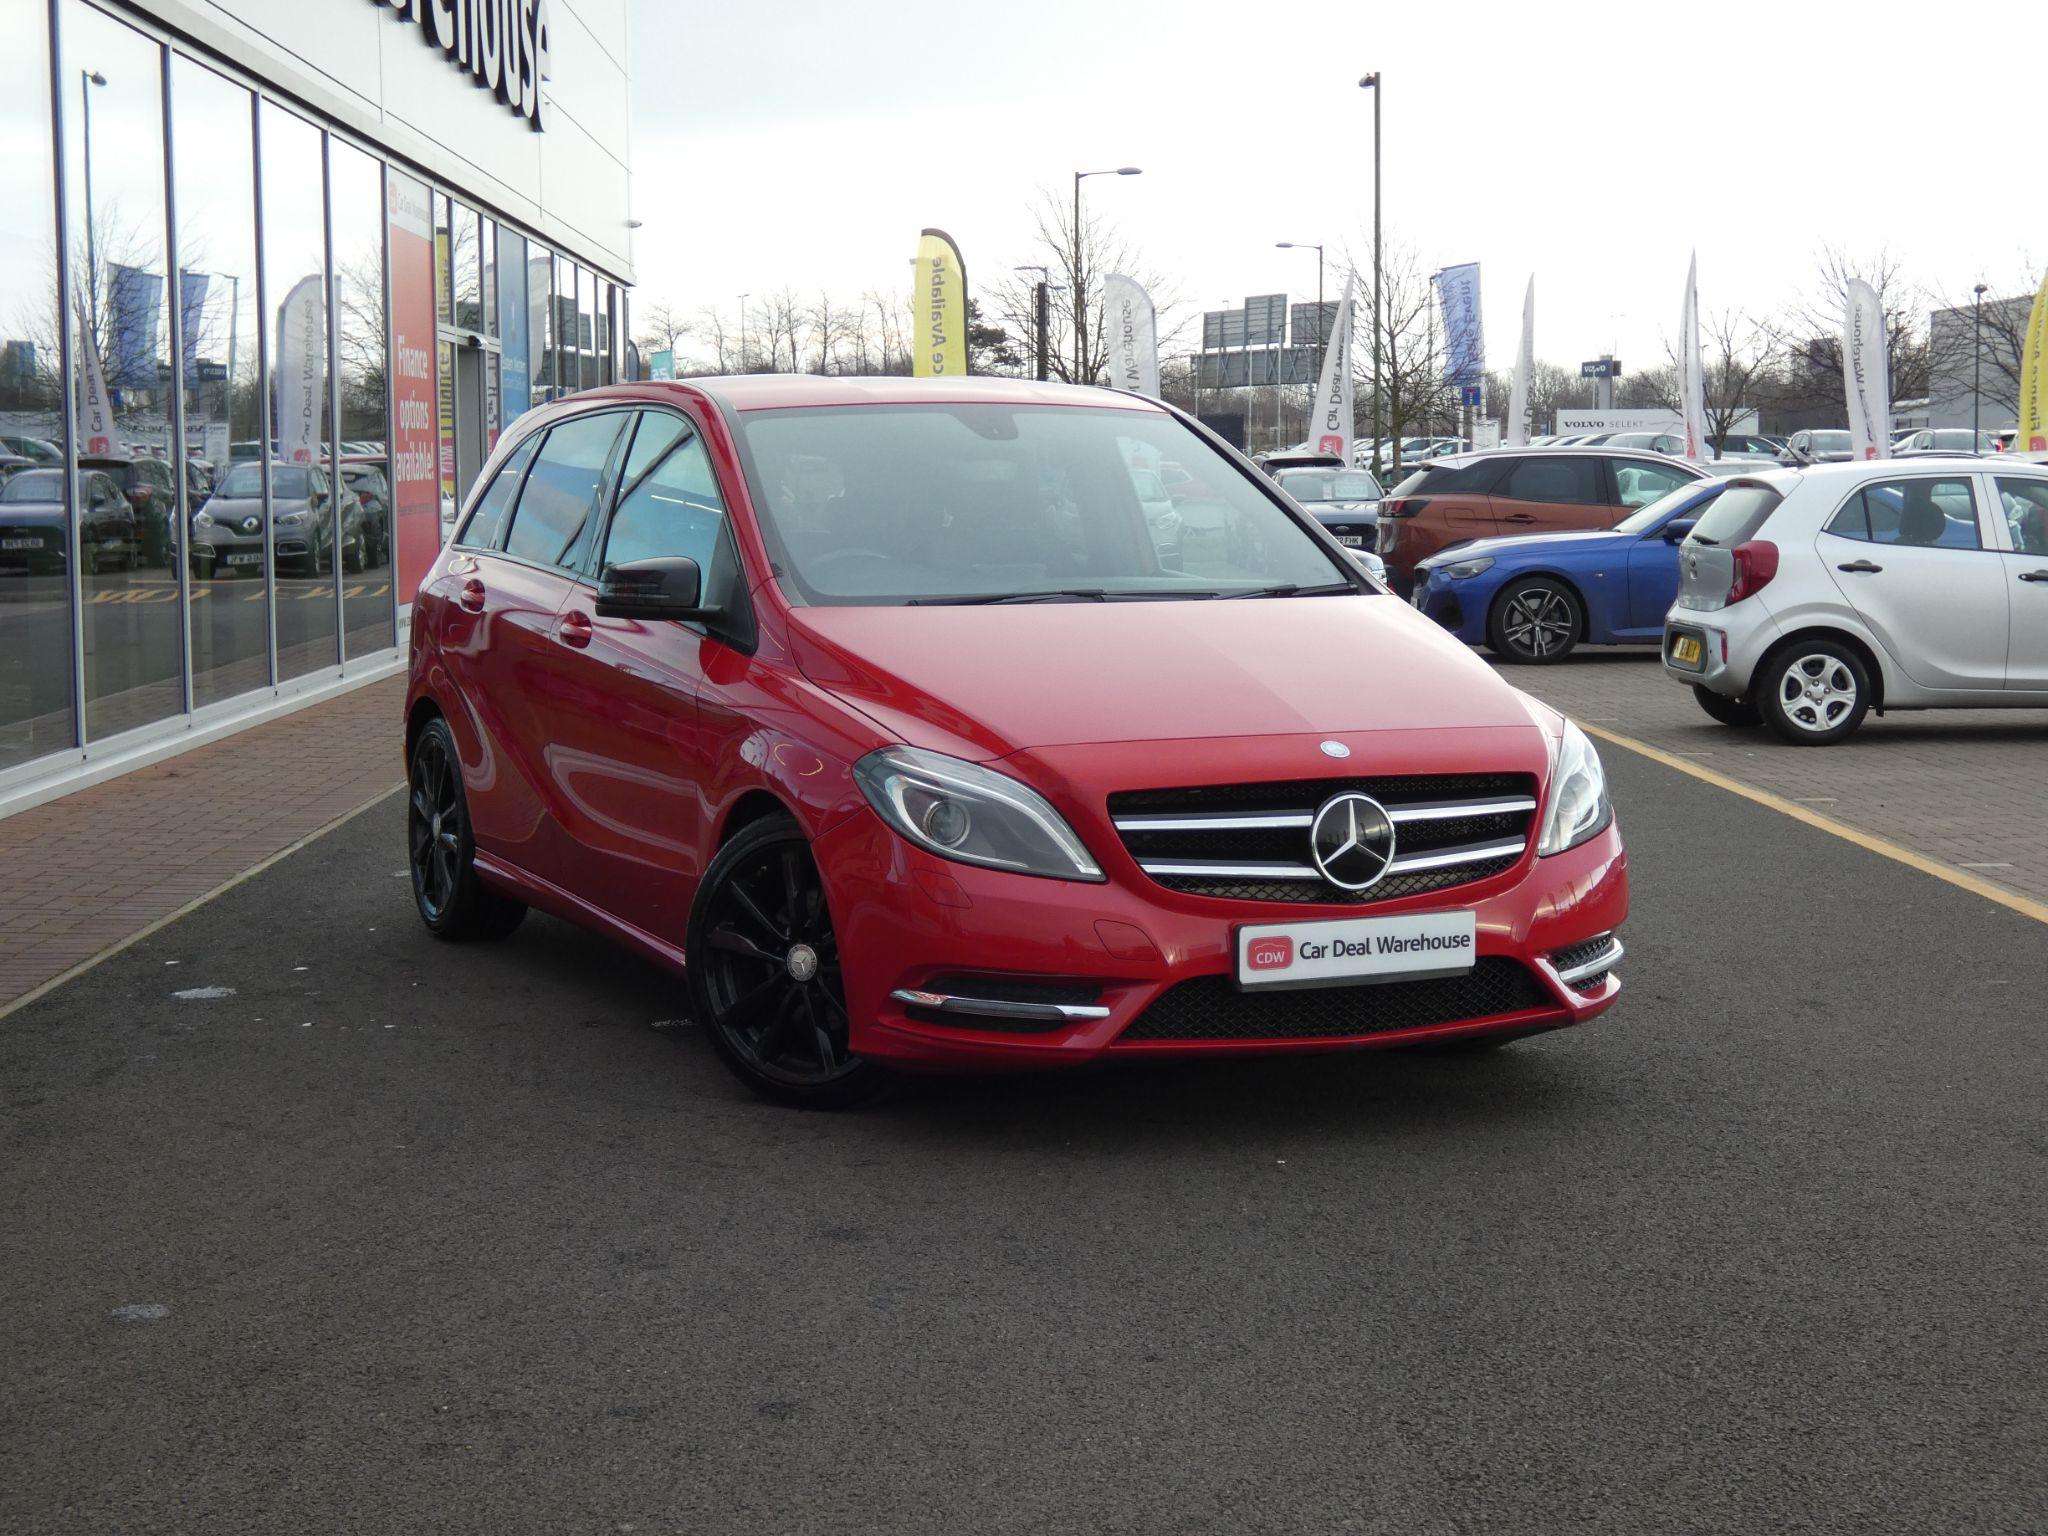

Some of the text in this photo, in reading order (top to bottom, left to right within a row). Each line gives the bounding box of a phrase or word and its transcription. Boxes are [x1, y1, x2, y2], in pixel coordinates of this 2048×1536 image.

[398, 335, 428, 379] Finance
[91, 409, 102, 433] Car
[400, 390, 429, 441] options
[1564, 420, 1645, 428] VOLVO SELEKT
[396, 441, 434, 482] available!
[1256, 951, 1285, 964] CDW
[1299, 932, 1471, 960] Car Deal Warehouse
